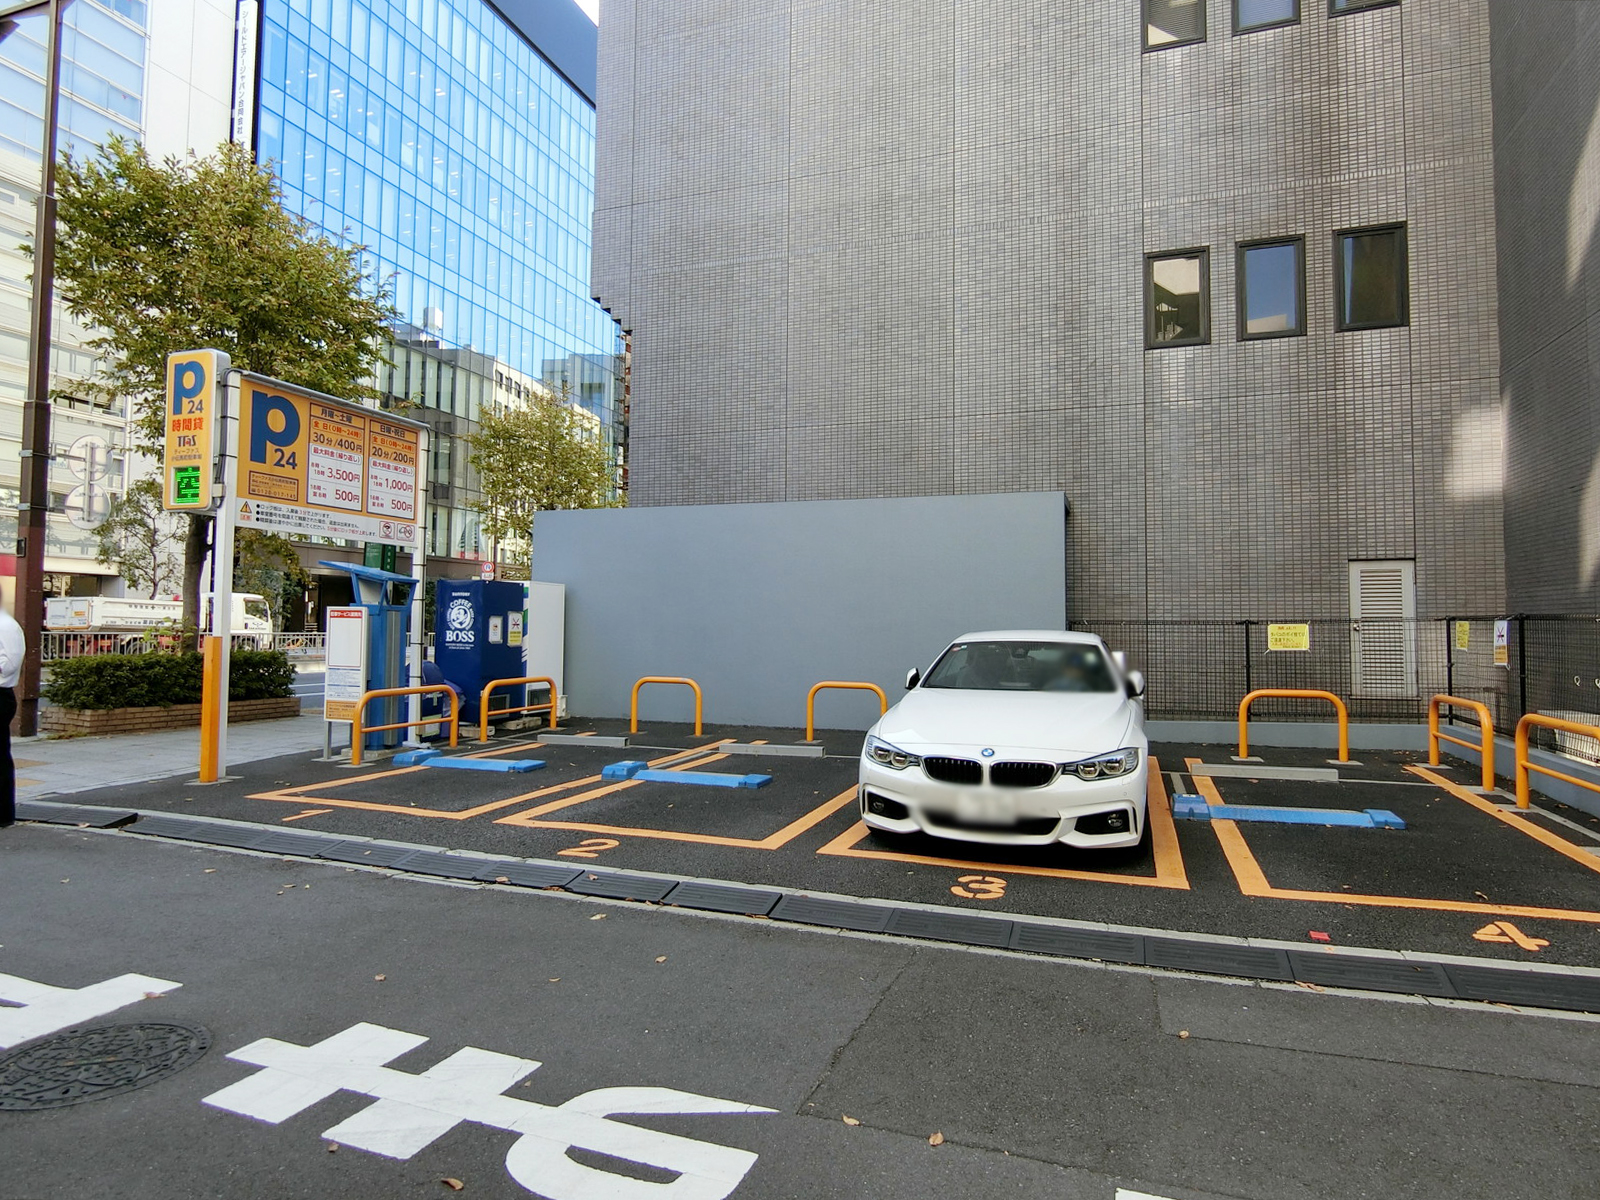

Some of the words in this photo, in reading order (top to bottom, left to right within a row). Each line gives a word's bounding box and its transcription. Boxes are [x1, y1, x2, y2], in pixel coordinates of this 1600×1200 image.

[187, 399, 204, 414] 24
[171, 417, 204, 432] 時間貸
[273, 448, 298, 471] 24
[327, 467, 360, 483] 3,500円
[385, 478, 413, 493] 1,000円
[335, 489, 360, 503] 500円
[391, 499, 413, 512] 500円
[449, 598, 473, 609] COFFEE
[445, 630, 475, 643] BOSS
[557, 837, 621, 859] 2
[950, 874, 1008, 900] 3
[1472, 920, 1551, 952] 4
